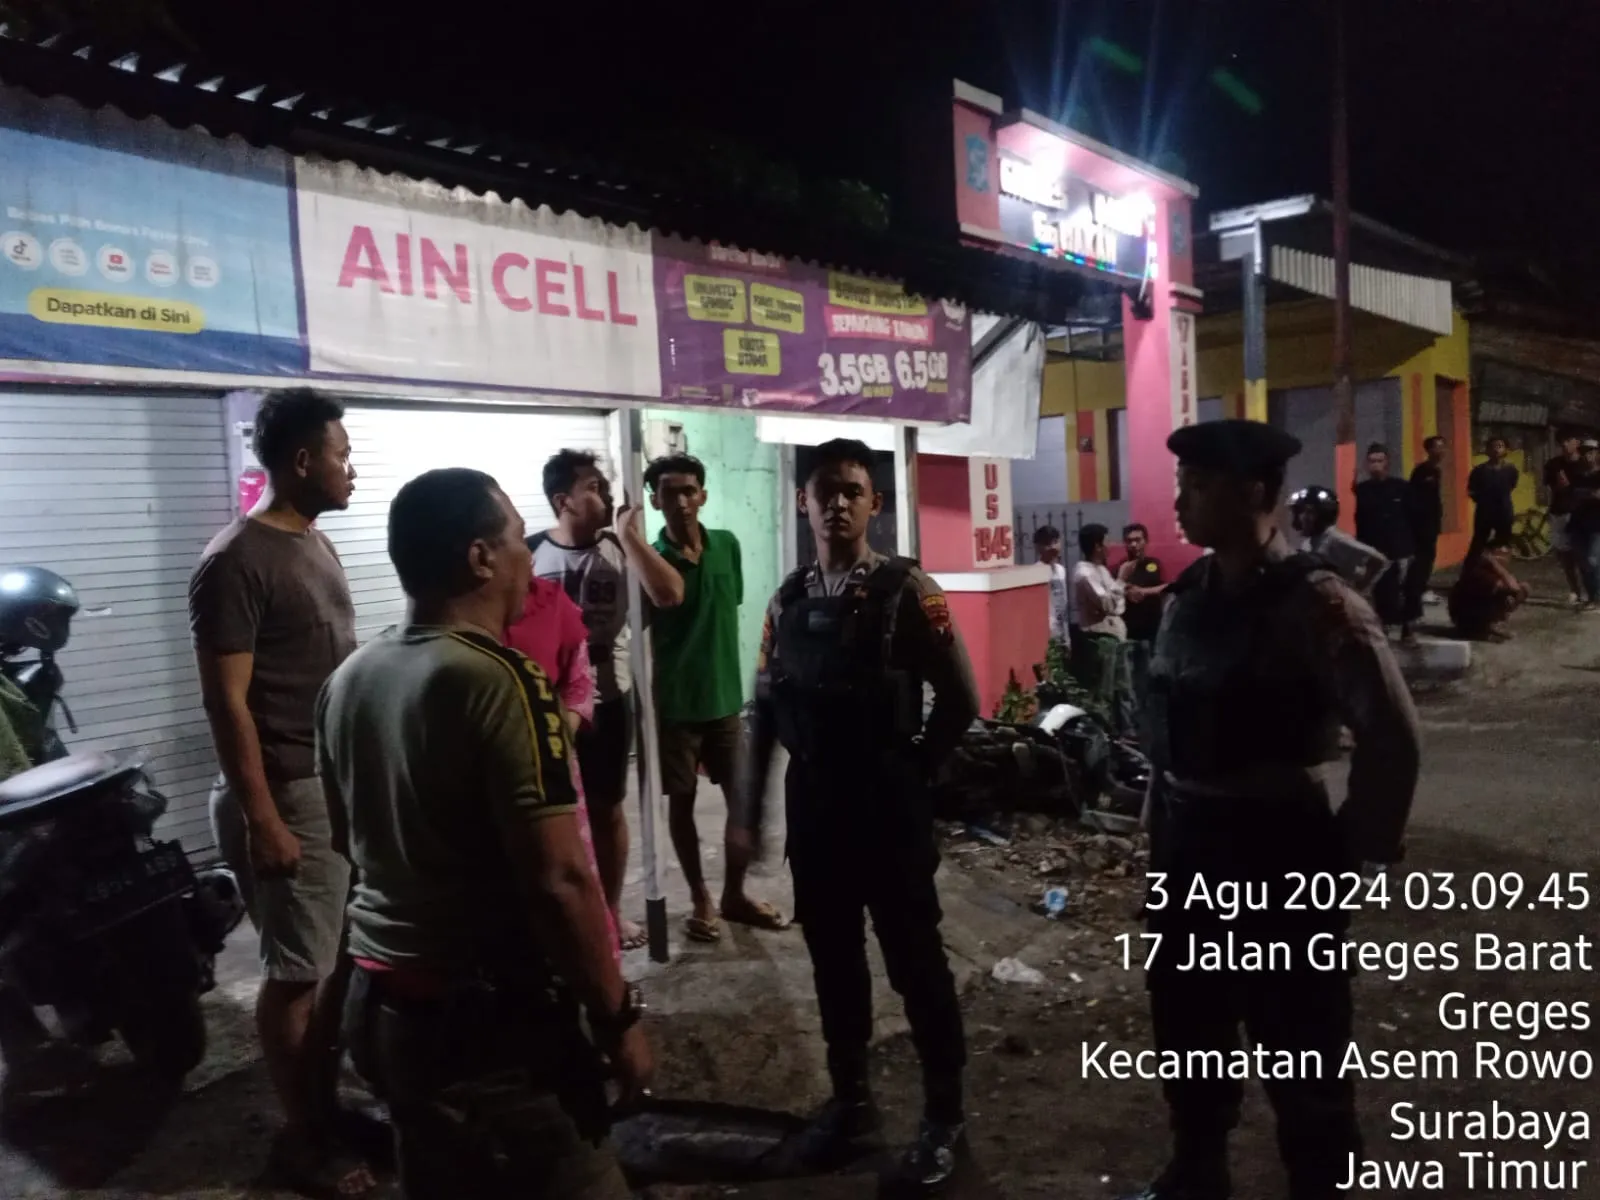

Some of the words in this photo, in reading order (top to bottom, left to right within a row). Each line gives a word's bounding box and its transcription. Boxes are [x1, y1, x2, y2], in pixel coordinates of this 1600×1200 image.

[336, 225, 472, 305] AIN
[491, 251, 638, 327] CELL
[47, 296, 137, 321] Dapatkan
[140, 306, 157, 321] di
[161, 308, 191, 325] Sini
[817, 352, 893, 397] 3.5GB
[974, 526, 1012, 562] 1945
